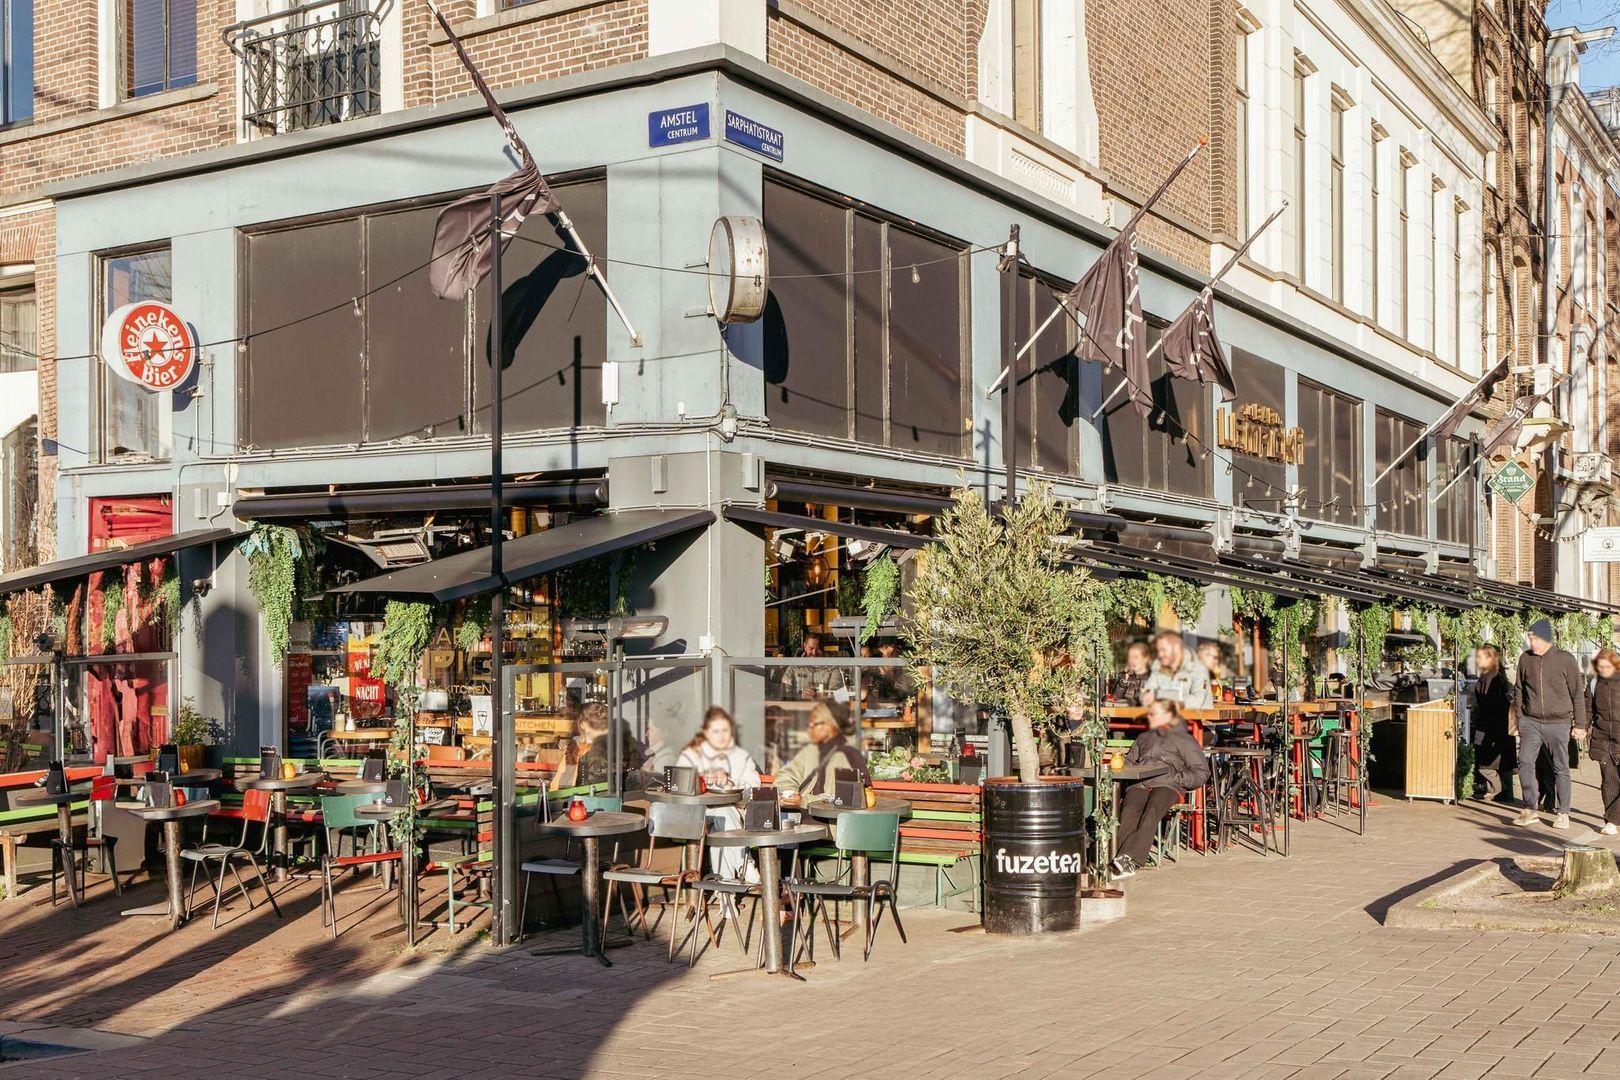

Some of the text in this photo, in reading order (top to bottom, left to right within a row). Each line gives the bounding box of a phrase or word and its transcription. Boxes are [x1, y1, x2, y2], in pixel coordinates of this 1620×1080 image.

[660, 110, 698, 128] AMSTEL
[667, 126, 698, 140] CENTRUM
[727, 113, 782, 147] SARPHATISTRAAT
[761, 143, 782, 157] CENTRUM
[141, 363, 179, 385] Bier
[1497, 474, 1526, 484] Brand
[355, 685, 380, 701] NACHT
[995, 848, 1081, 874] fuzetea
